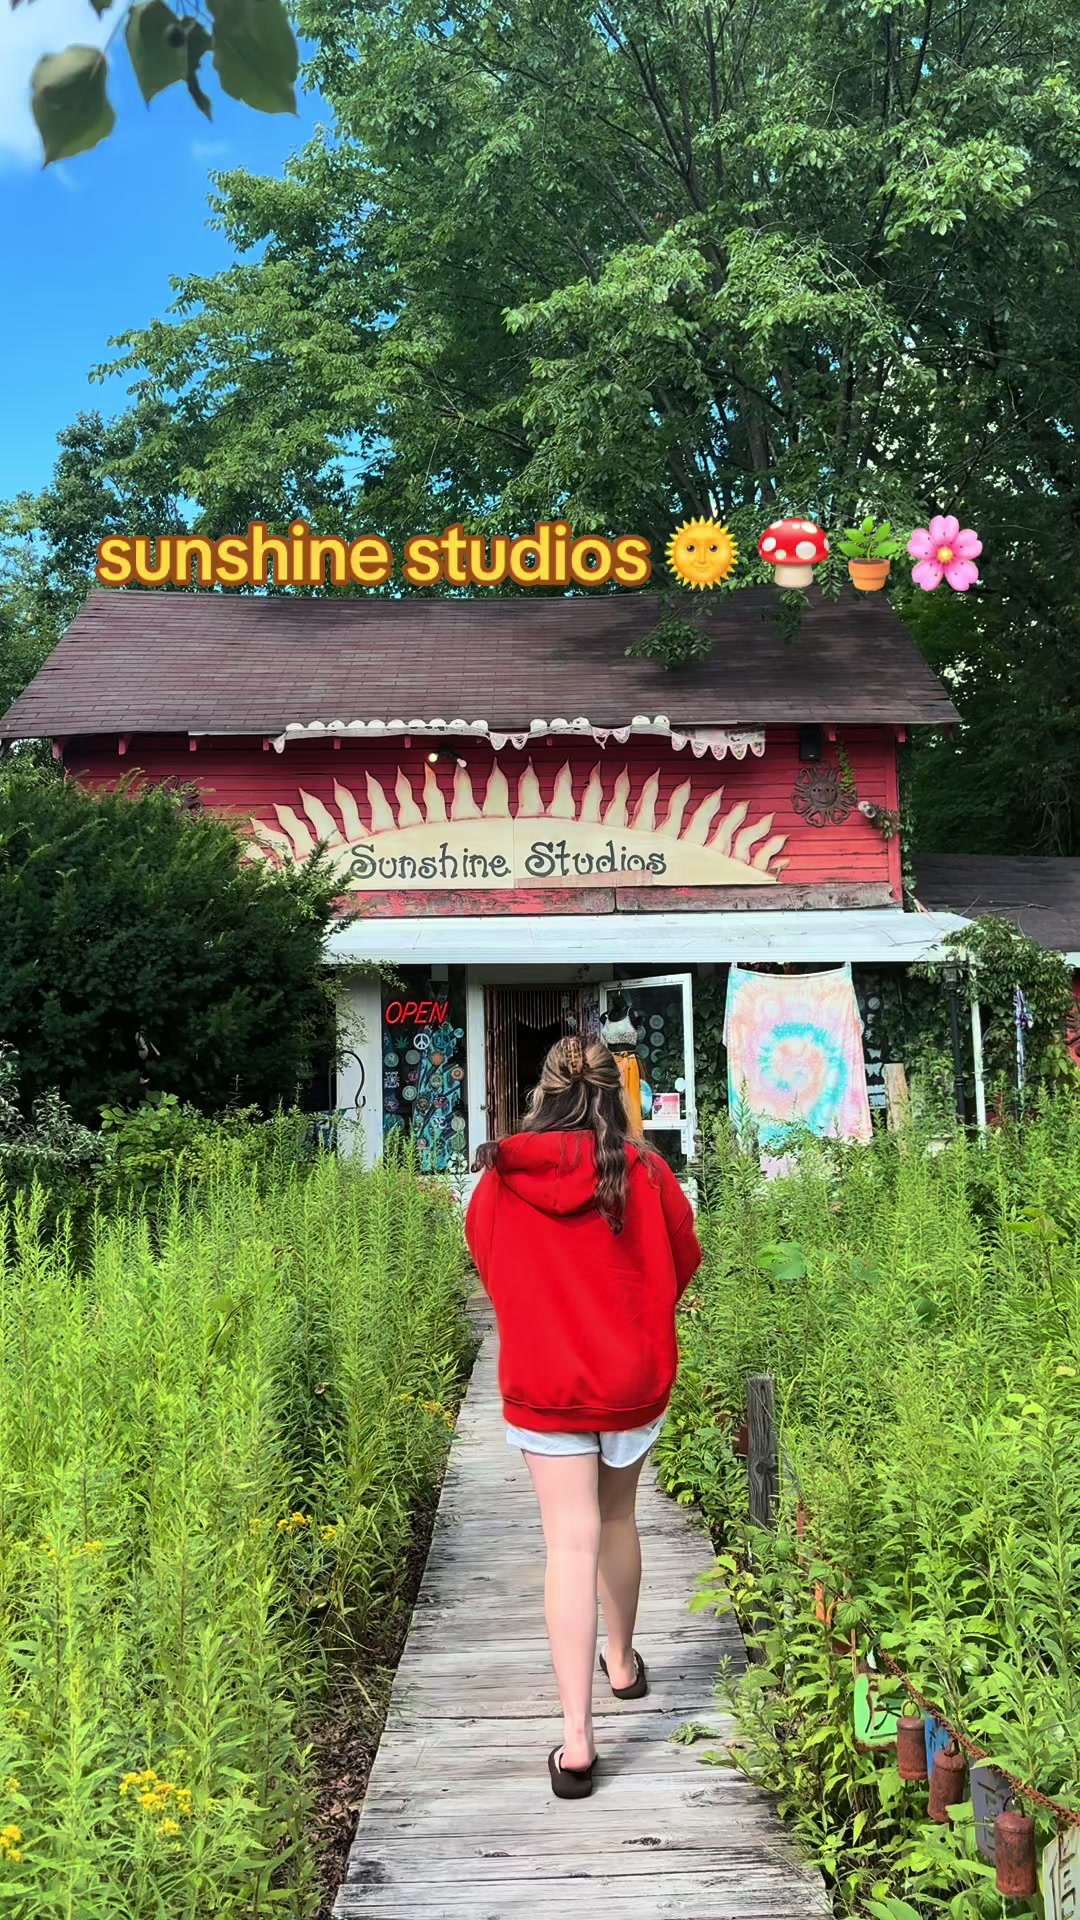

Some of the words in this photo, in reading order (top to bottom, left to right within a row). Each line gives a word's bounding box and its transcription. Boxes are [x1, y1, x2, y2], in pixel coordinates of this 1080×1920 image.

[350, 842, 511, 879] Sunshine
[525, 840, 667, 877] Studios
[385, 1001, 448, 1024] OPEN
